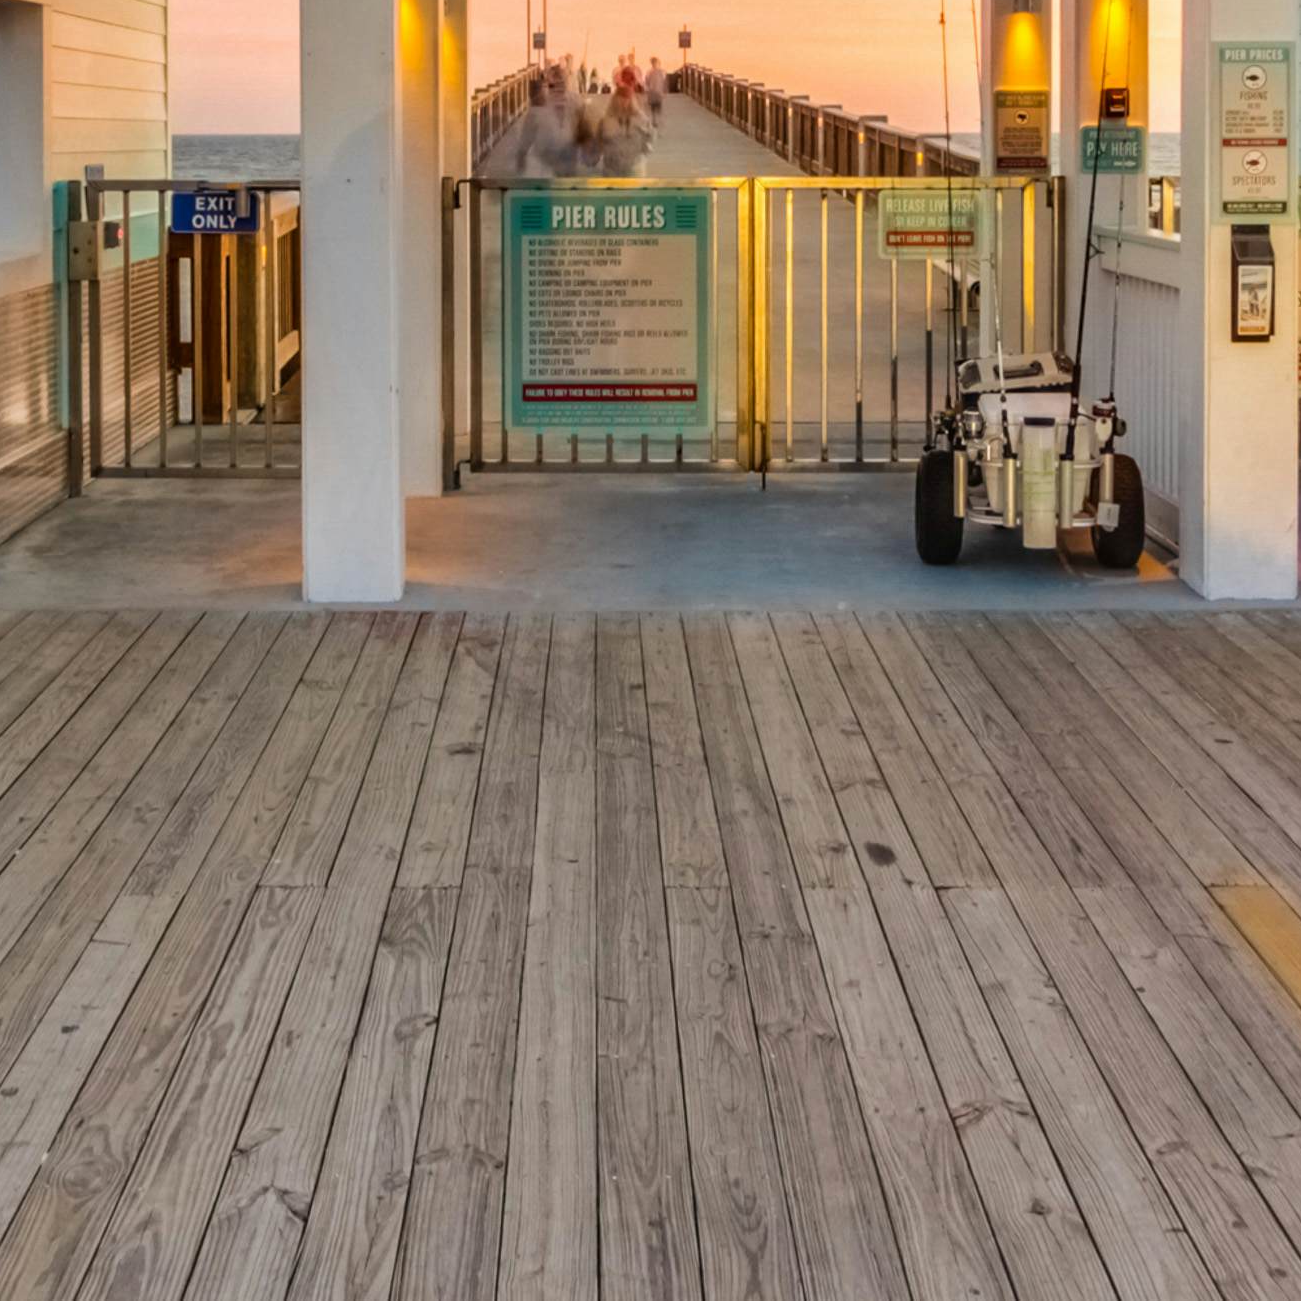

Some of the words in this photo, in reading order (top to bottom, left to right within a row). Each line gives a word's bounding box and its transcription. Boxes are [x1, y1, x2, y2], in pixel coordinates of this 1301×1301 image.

[1225, 49, 1247, 61] PIER
[1250, 49, 1284, 61] PRICES
[1239, 90, 1268, 101] FISHING
[1111, 142, 1138, 157] HERE
[1232, 176, 1276, 186] SPECTATORS
[195, 197, 235, 211] EXIT
[886, 198, 925, 213] RELEASE
[953, 198, 974, 213] FISH
[191, 214, 237, 229] ONLY
[552, 205, 595, 229] PIER
[604, 205, 666, 229] RULES
[927, 216, 936, 228] IN
[937, 216, 967, 228] COLER
